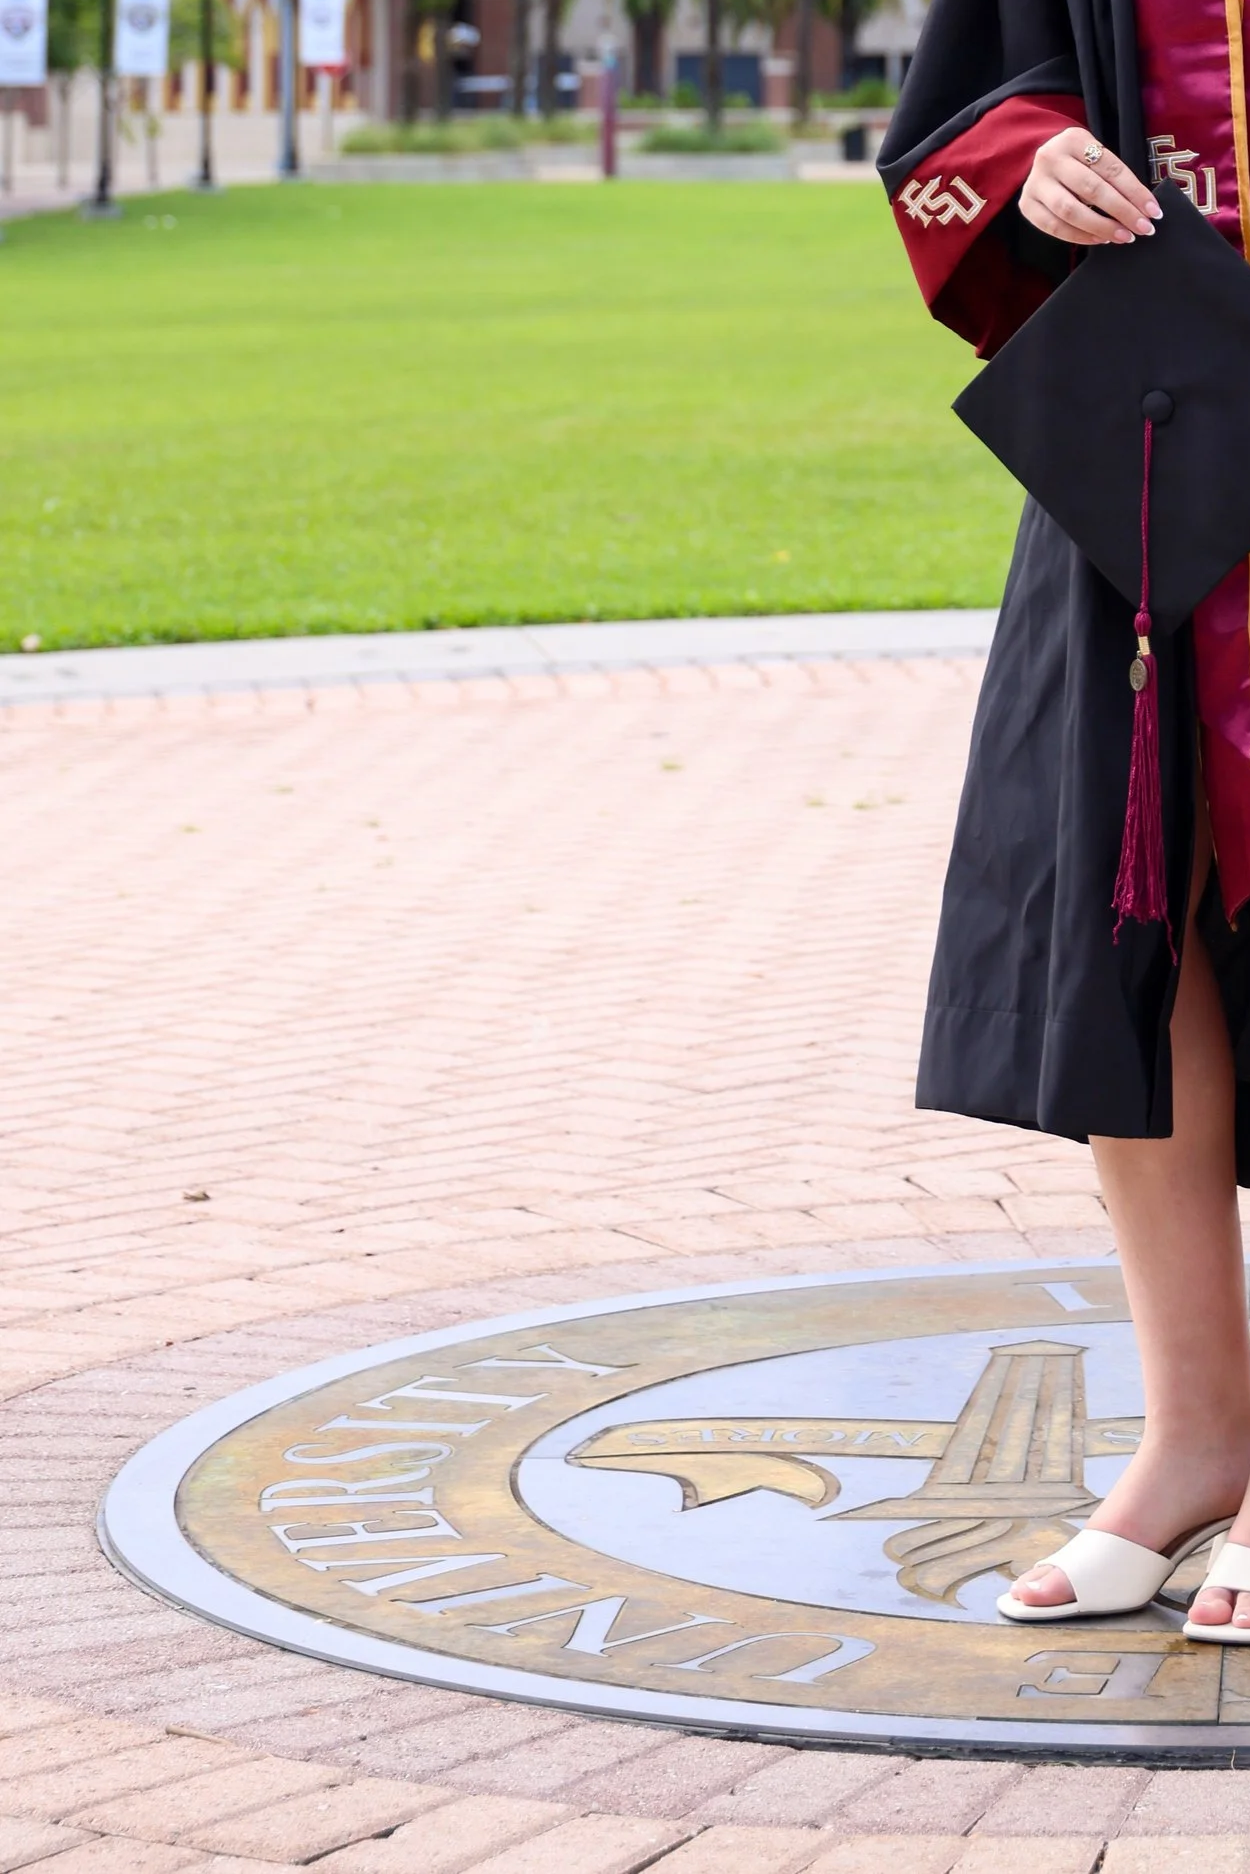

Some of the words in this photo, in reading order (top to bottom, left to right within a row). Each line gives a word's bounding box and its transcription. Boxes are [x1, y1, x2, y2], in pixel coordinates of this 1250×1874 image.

[897, 175, 988, 229] FSU
[627, 1424, 933, 1447] MORES
[258, 1343, 879, 1686] UNIVERSITY
